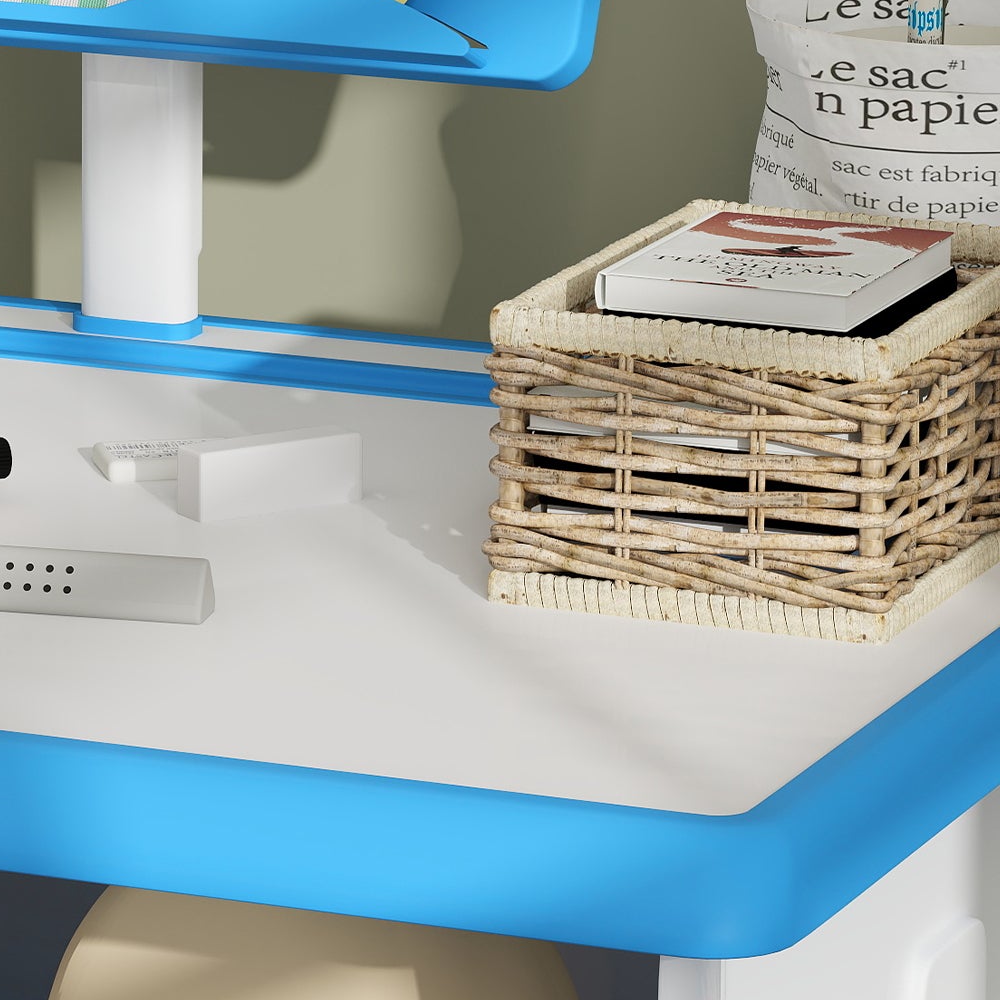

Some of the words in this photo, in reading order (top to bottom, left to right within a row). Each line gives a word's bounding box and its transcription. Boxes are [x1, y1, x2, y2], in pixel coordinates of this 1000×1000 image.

[858, 94, 999, 135] papie
[831, 159, 872, 177] sac
[878, 167, 914, 182] est
[921, 164, 999, 187] fabriq
[887, 196, 919, 214] de
